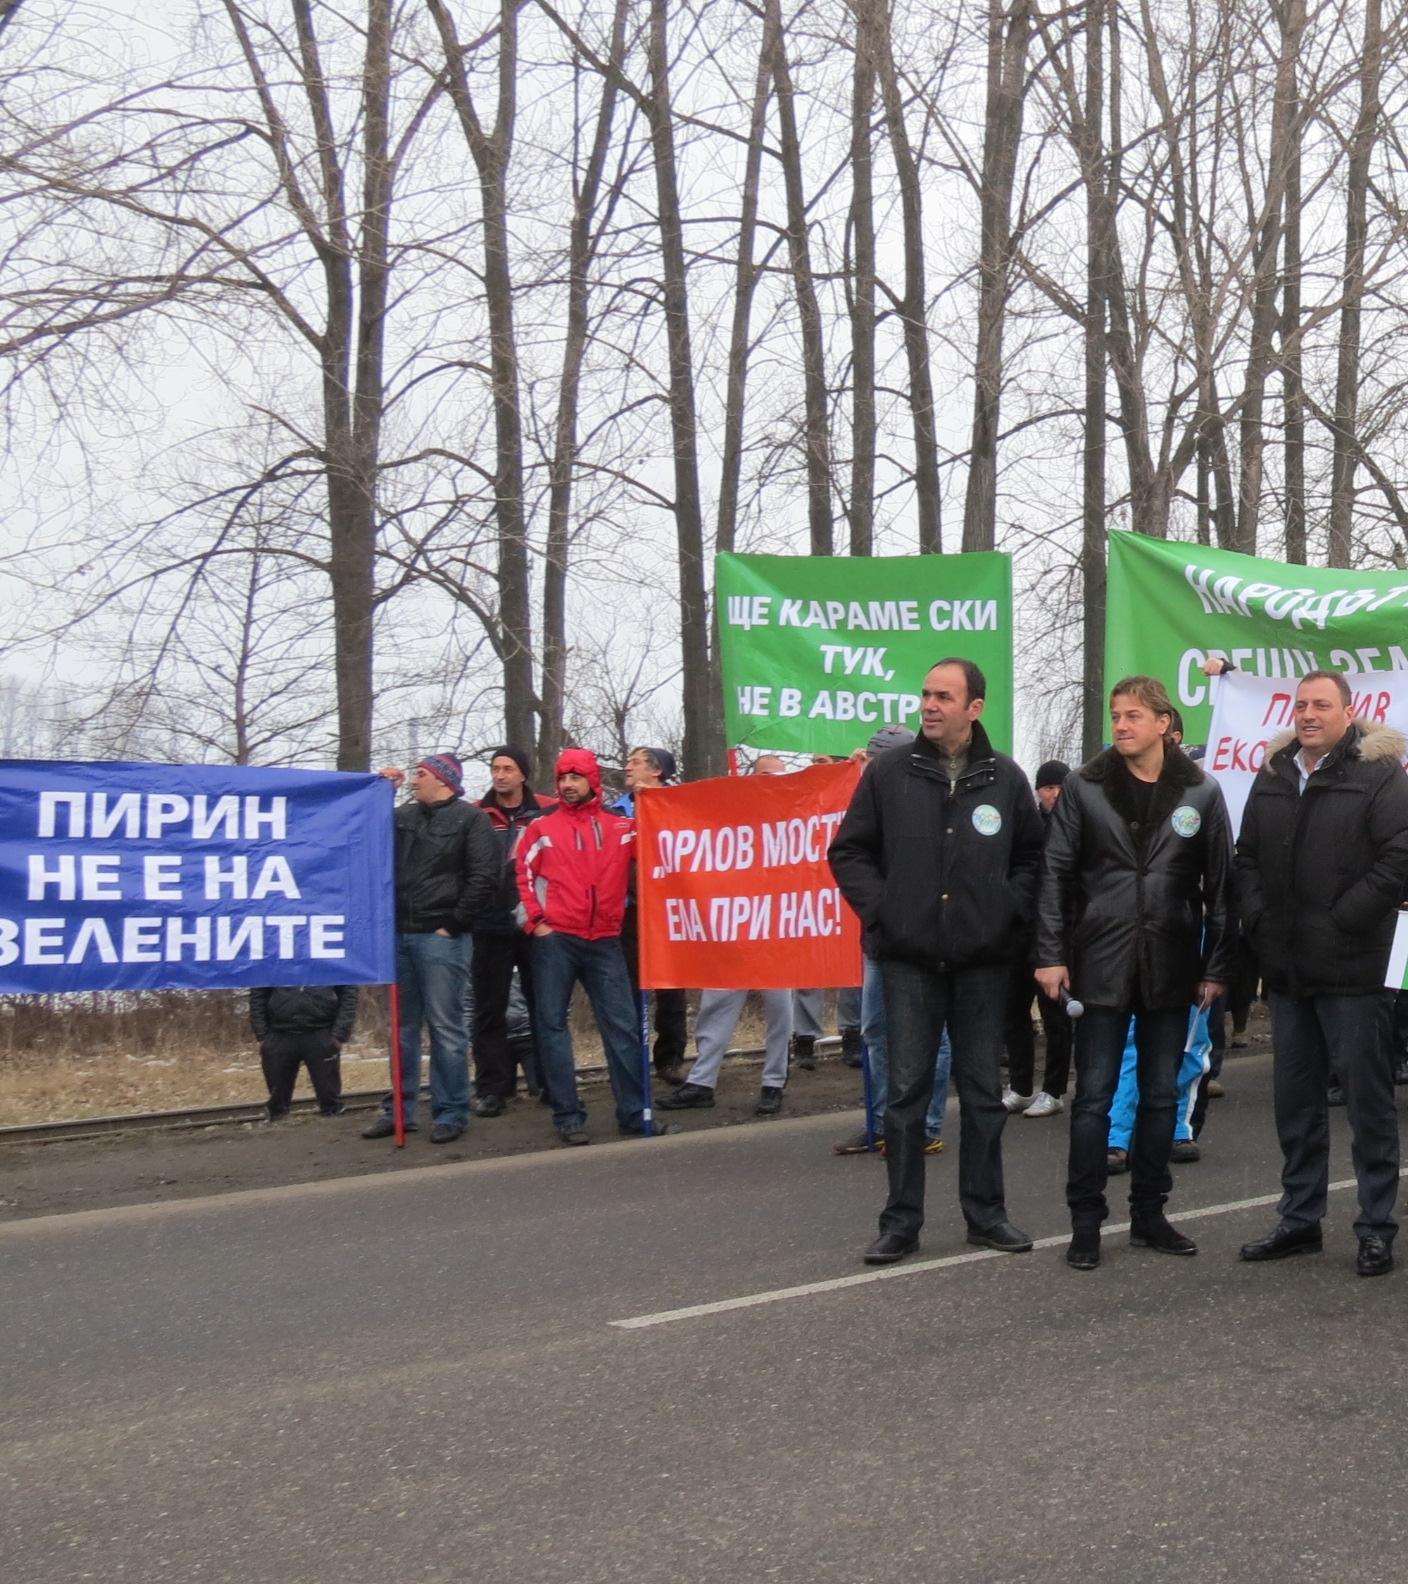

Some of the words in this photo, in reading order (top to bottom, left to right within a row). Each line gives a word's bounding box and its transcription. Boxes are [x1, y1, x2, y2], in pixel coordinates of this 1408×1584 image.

[728, 596, 772, 631] ЩЕ
[779, 599, 921, 631] КАРАМЕ
[929, 600, 998, 631] СКИ
[820, 645, 897, 681] ТУК,
[737, 686, 772, 716] НЕ
[779, 688, 802, 718] В
[809, 692, 923, 724] АВСТР
[38, 791, 287, 840] ПИРИН
[28, 855, 122, 901] НЕ
[144, 855, 183, 900] Е
[204, 855, 302, 900] НА
[665, 898, 707, 942] ЕЛА
[709, 894, 772, 942] ПРИ
[778, 887, 842, 940] НАС!
